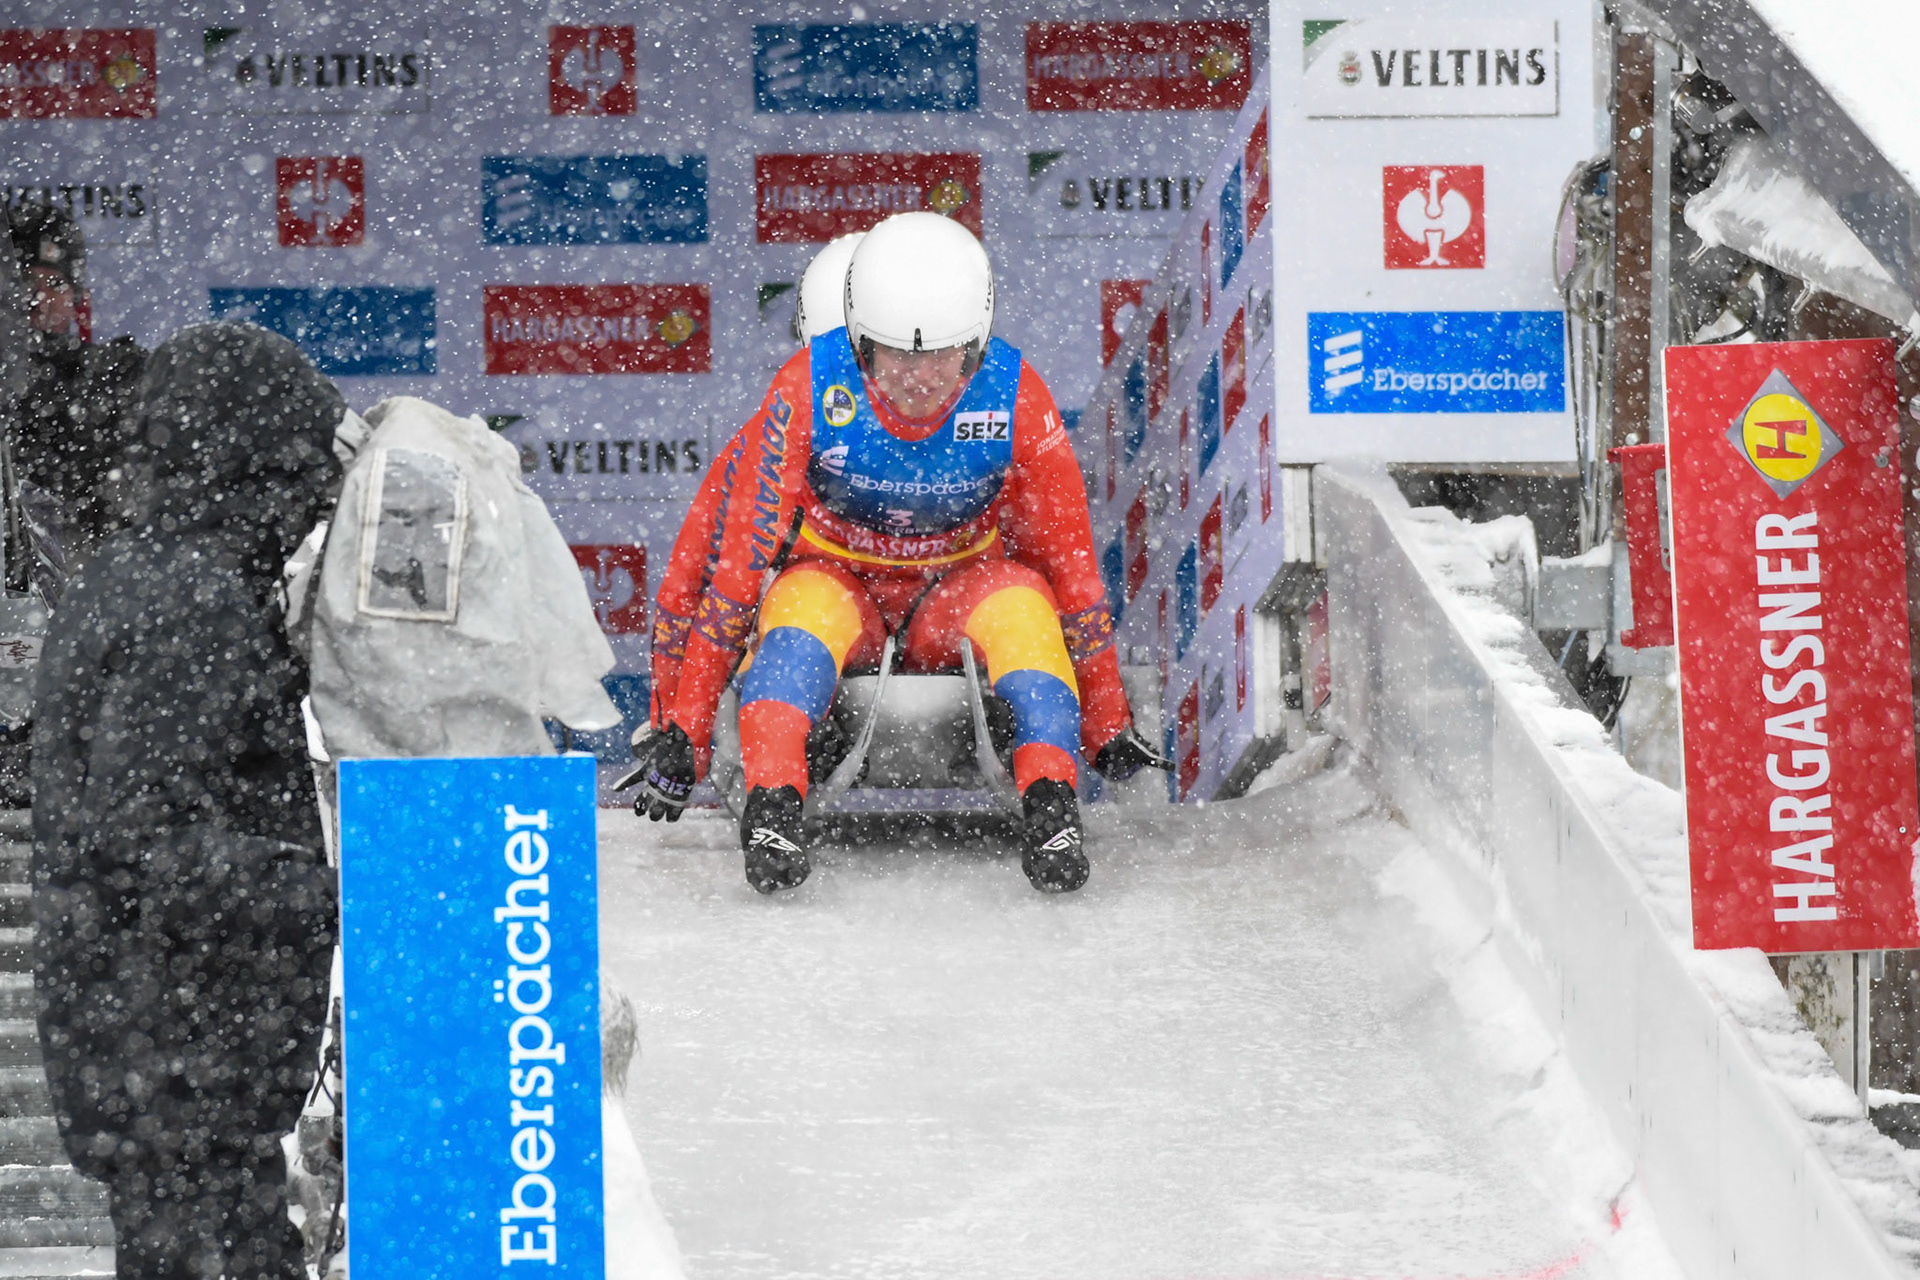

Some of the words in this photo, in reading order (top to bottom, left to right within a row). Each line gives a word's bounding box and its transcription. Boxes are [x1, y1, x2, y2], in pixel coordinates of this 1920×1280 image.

[266, 54, 418, 87] VELTINS
[1371, 48, 1547, 87] VELTINS
[491, 316, 650, 342] HARGASSNER
[1372, 368, 1548, 395] Eberspächer
[546, 440, 700, 474] VELTINS
[748, 388, 794, 571] ROMANIA
[884, 509, 914, 527] 3
[1754, 510, 1838, 922] HARGASSNER
[494, 804, 565, 1267] Eberspächer
